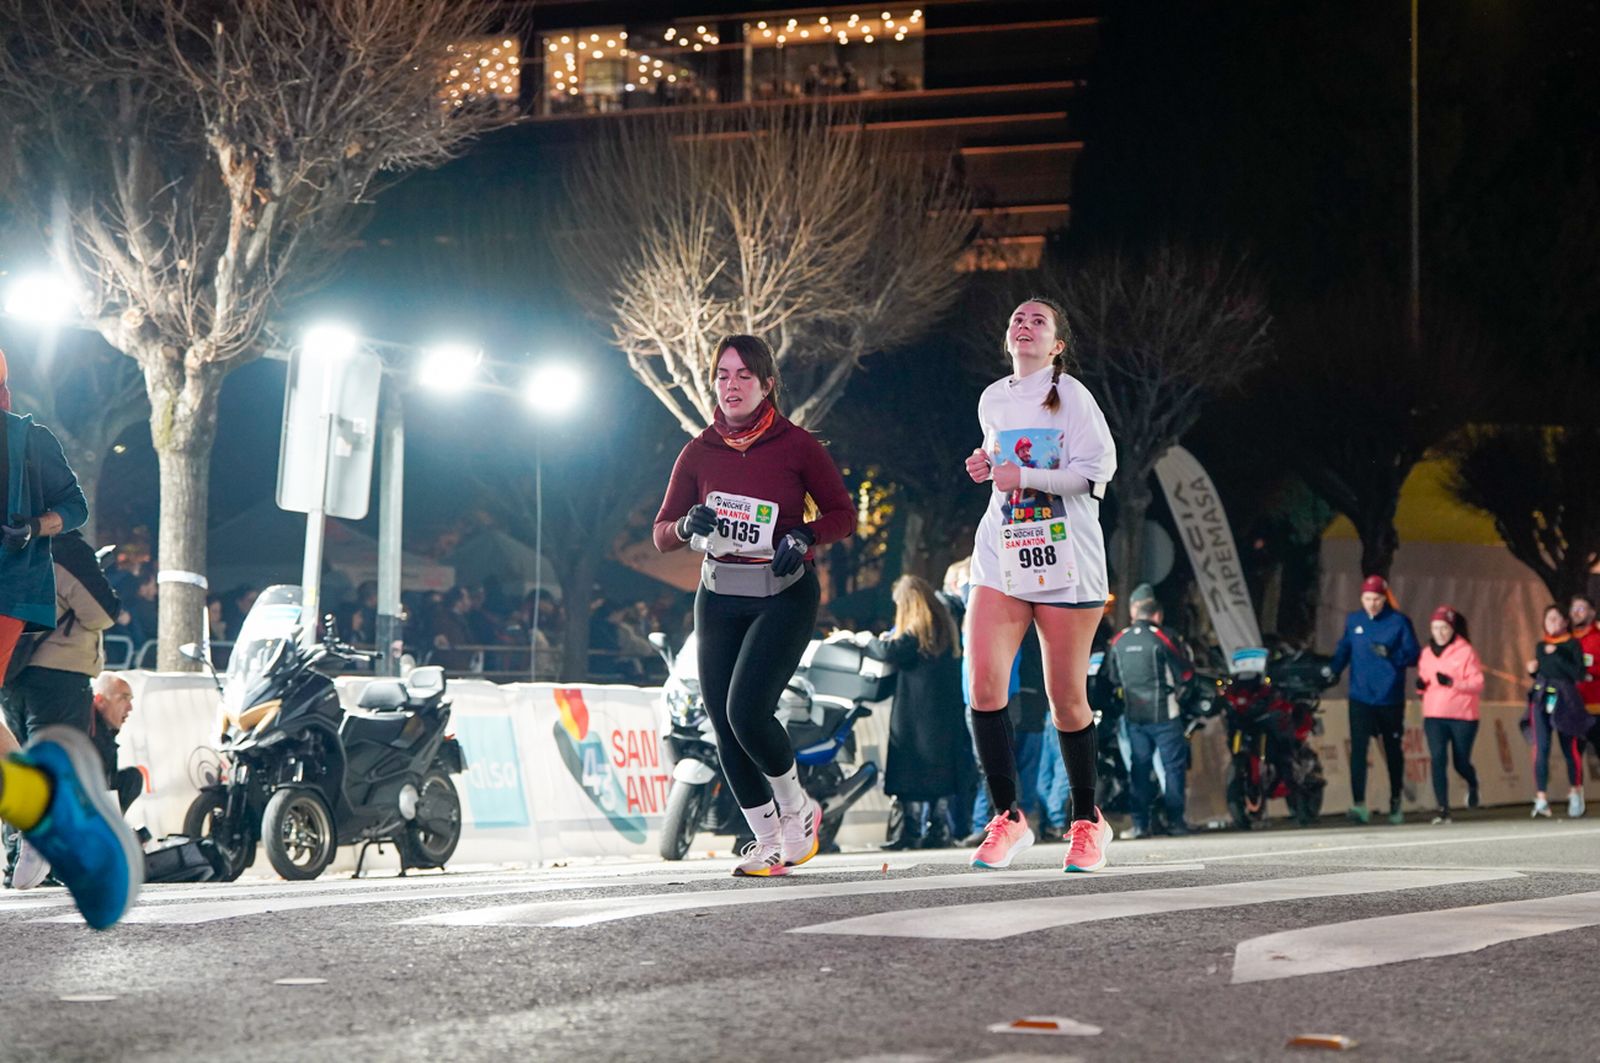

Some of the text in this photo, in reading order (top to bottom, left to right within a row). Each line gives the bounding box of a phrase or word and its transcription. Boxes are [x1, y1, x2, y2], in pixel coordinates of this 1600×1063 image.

[722, 500, 742, 510] NOCHE
[744, 504, 751, 513] DE
[717, 517, 760, 545] 6135
[1005, 539, 1021, 549] SAN
[1013, 529, 1034, 539] NOCHE
[1035, 528, 1044, 537] DE
[1190, 475, 1249, 608] JAPEMASA
[1018, 544, 1057, 569] 988
[611, 729, 659, 769] SAN
[582, 746, 617, 813] 43
[626, 774, 674, 815] ANT
